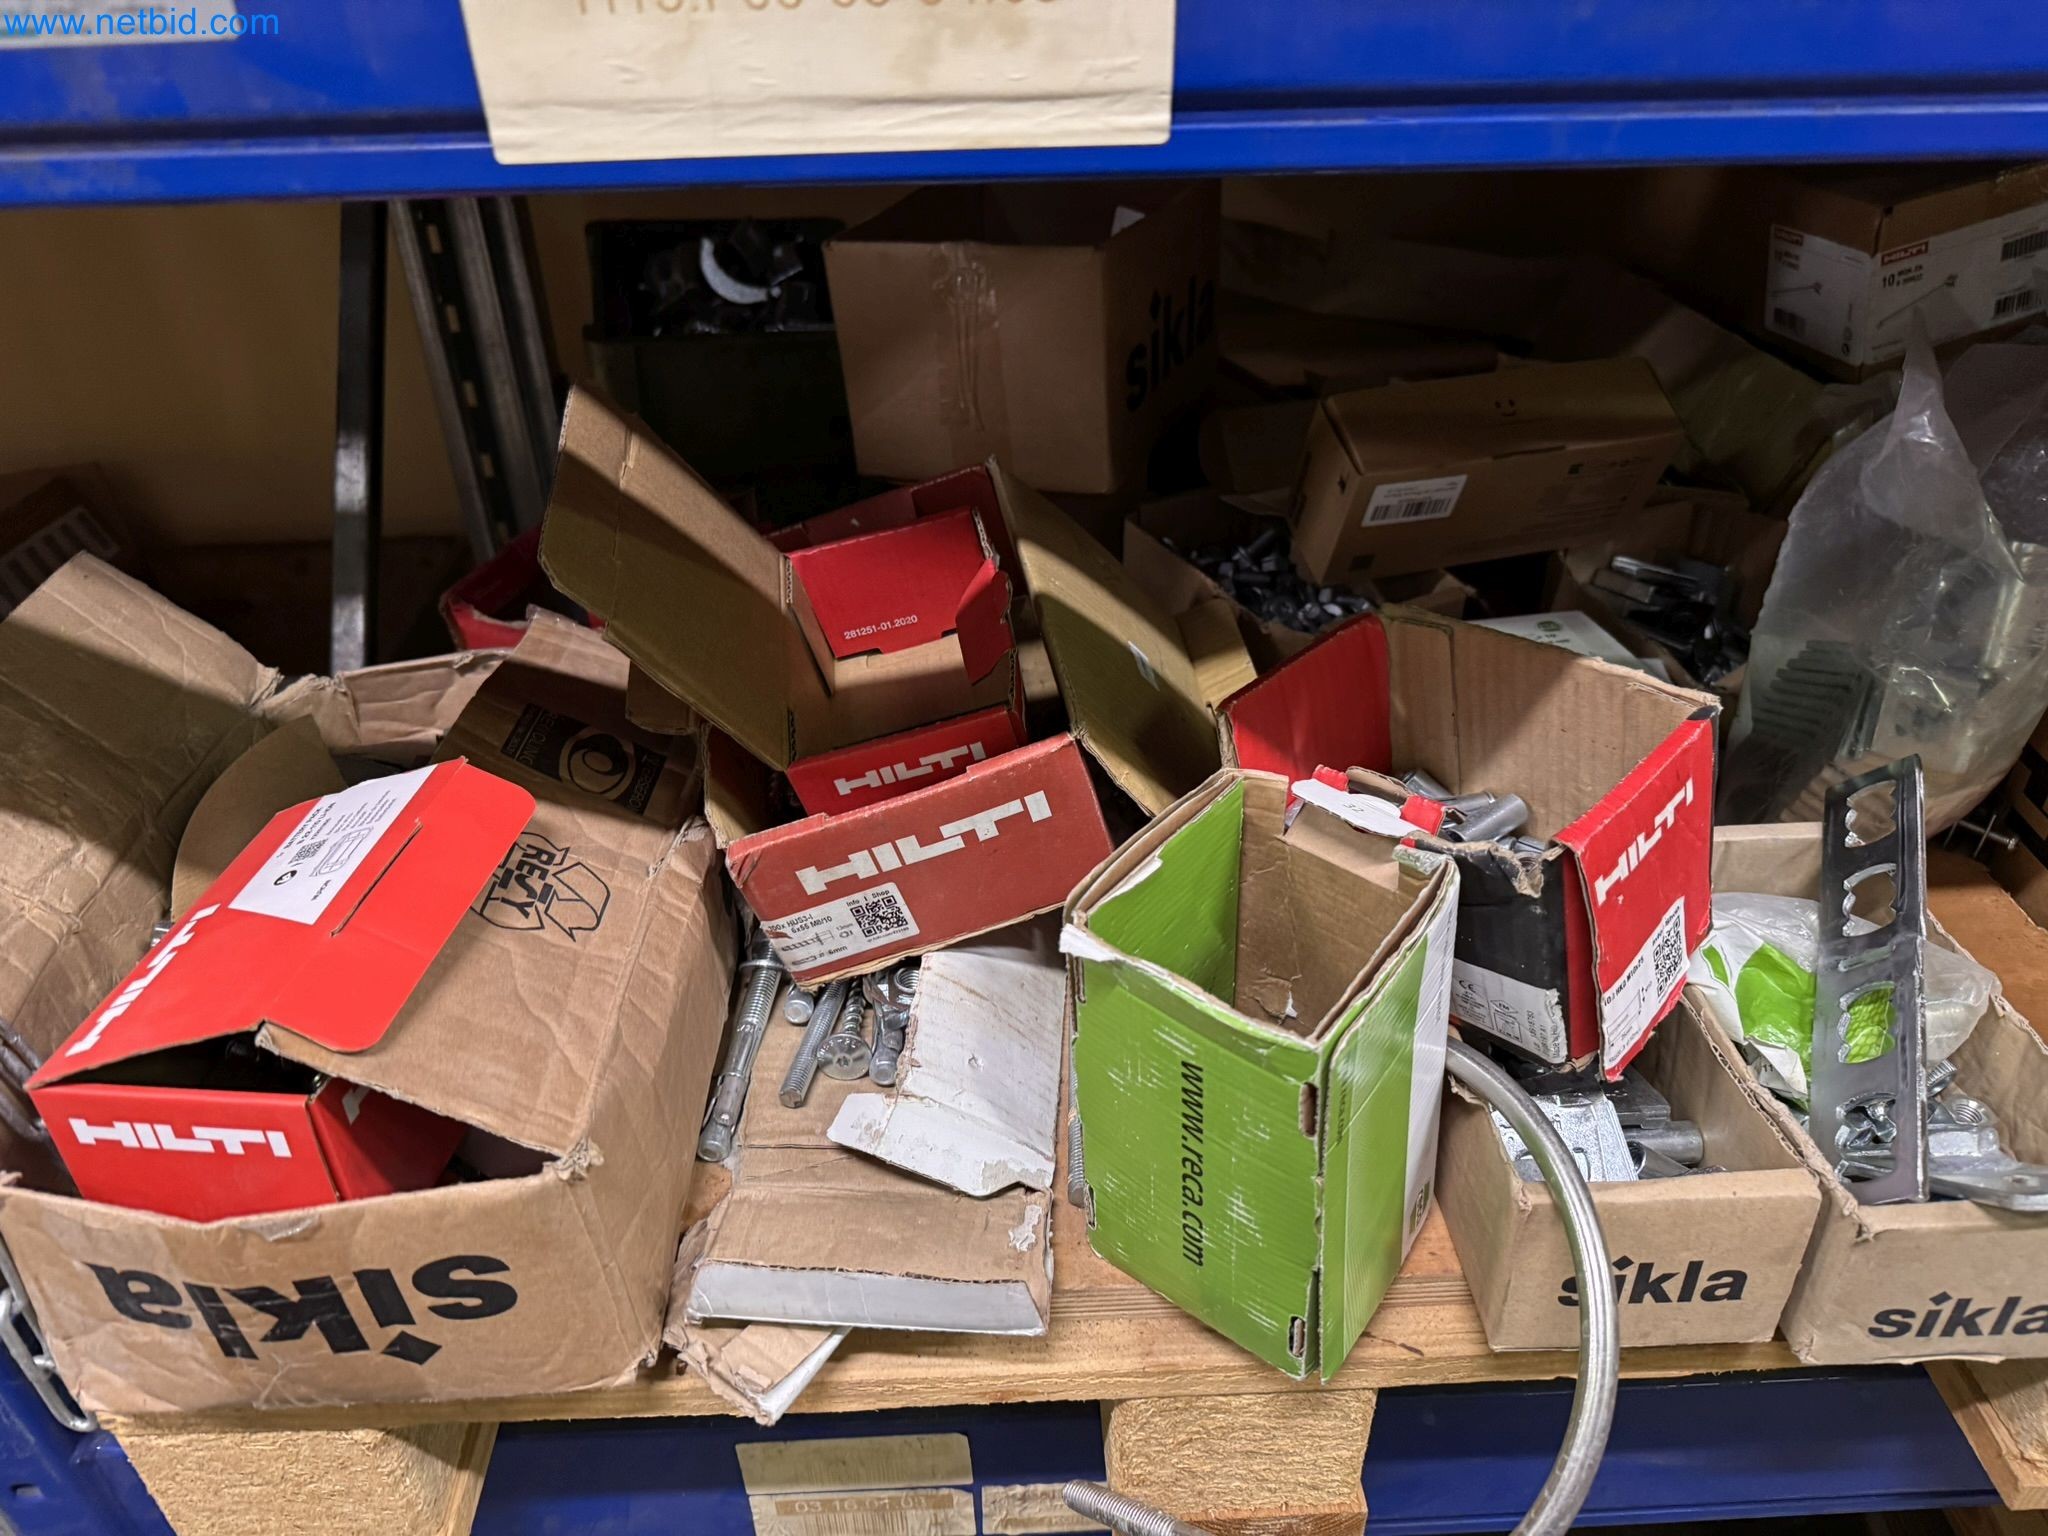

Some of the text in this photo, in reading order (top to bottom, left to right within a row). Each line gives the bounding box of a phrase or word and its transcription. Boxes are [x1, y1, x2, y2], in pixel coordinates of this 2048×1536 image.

[1125, 273, 1217, 412] sikla
[843, 614, 918, 641] 281251-01.2020
[833, 741, 987, 796] HILTI
[498, 843, 555, 920] RESY
[795, 790, 1053, 896] HILTI
[1593, 777, 1695, 906] HILTI
[65, 903, 222, 1058] HILTI
[69, 1117, 293, 1158] HILTI
[1179, 1059, 1206, 1268] www.reca.com
[83, 1254, 519, 1366] sikla
[1867, 1291, 2048, 1339] sikla
